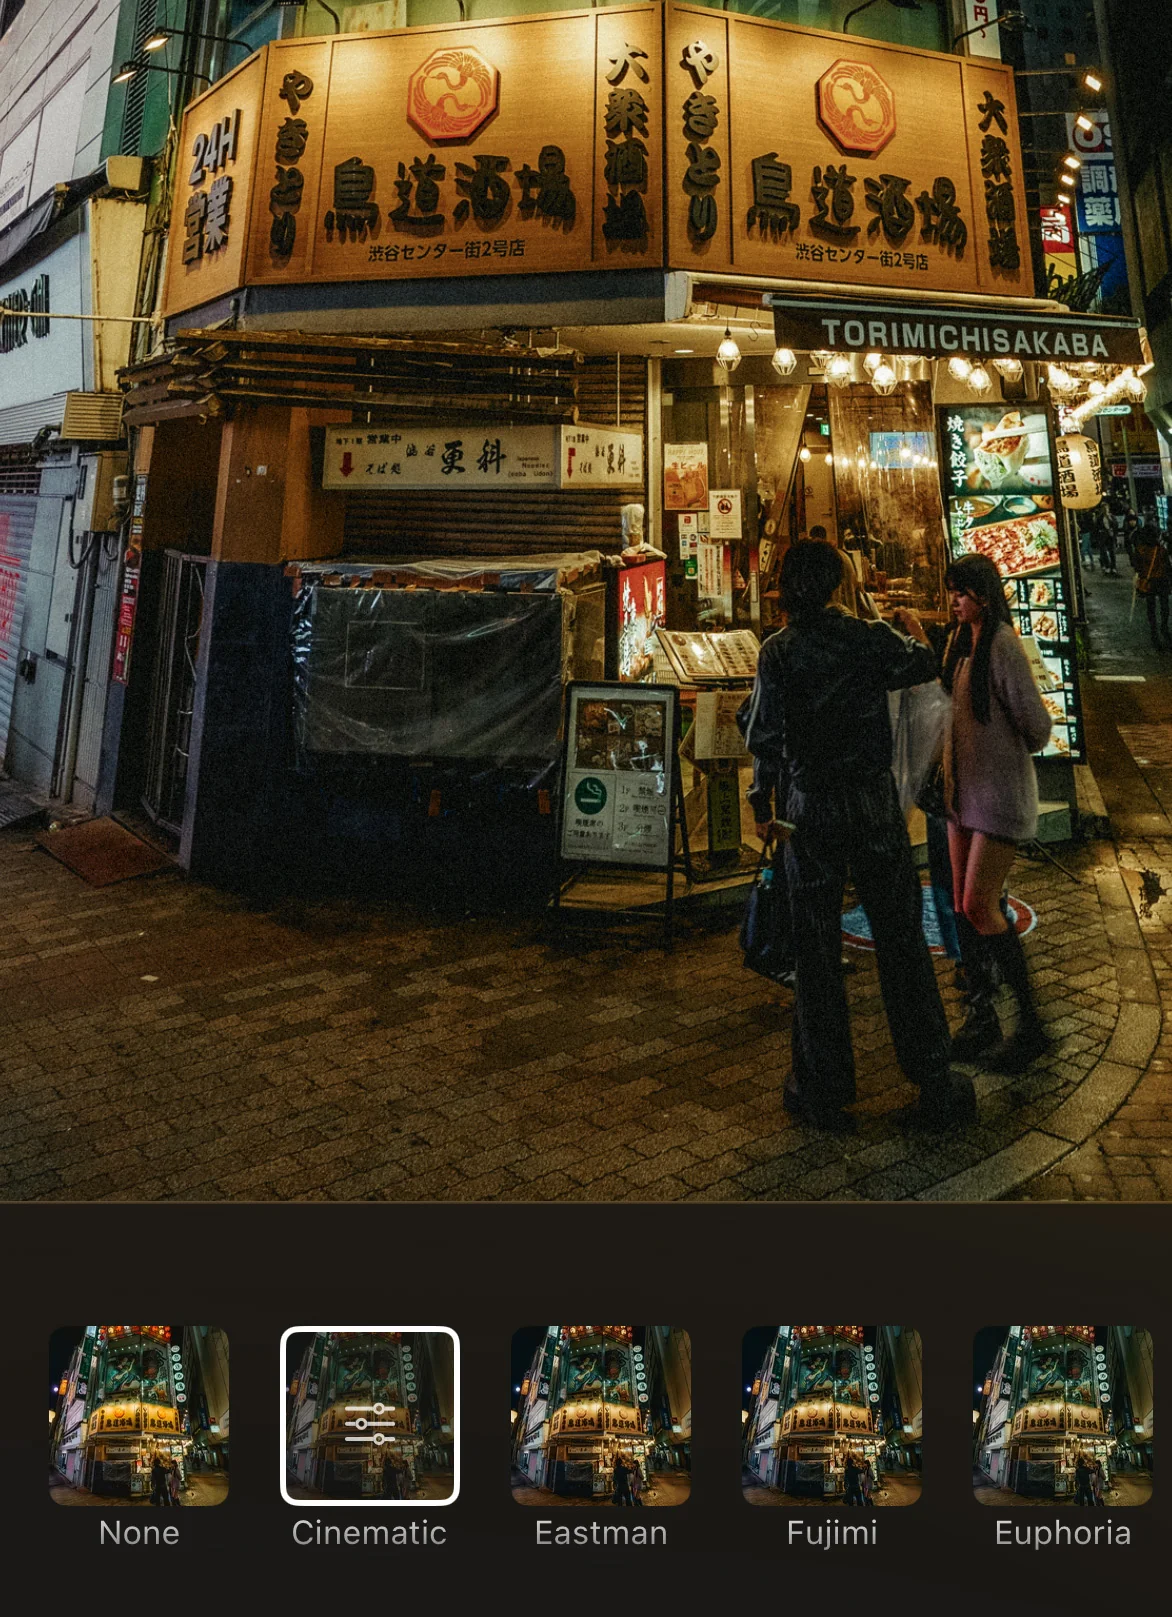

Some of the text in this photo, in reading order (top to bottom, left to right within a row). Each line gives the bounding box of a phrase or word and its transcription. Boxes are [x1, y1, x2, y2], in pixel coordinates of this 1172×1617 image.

[189, 108, 241, 185] 24H
[269, 69, 314, 258] やきとり
[602, 41, 650, 242] 大衆酒場
[680, 40, 720, 242] やきとり
[977, 90, 1021, 271] 大衆酒場
[182, 175, 232, 265] 営業
[324, 145, 577, 240] 鳥道酒場
[747, 152, 968, 256] 鳥道酒場
[368, 239, 526, 262] 渋谷センター街2号店
[795, 243, 928, 270] 渋谷センター街2号店
[821, 319, 1109, 358] TORIMICHISAKABA
[946, 415, 968, 488] 焼き餃子
